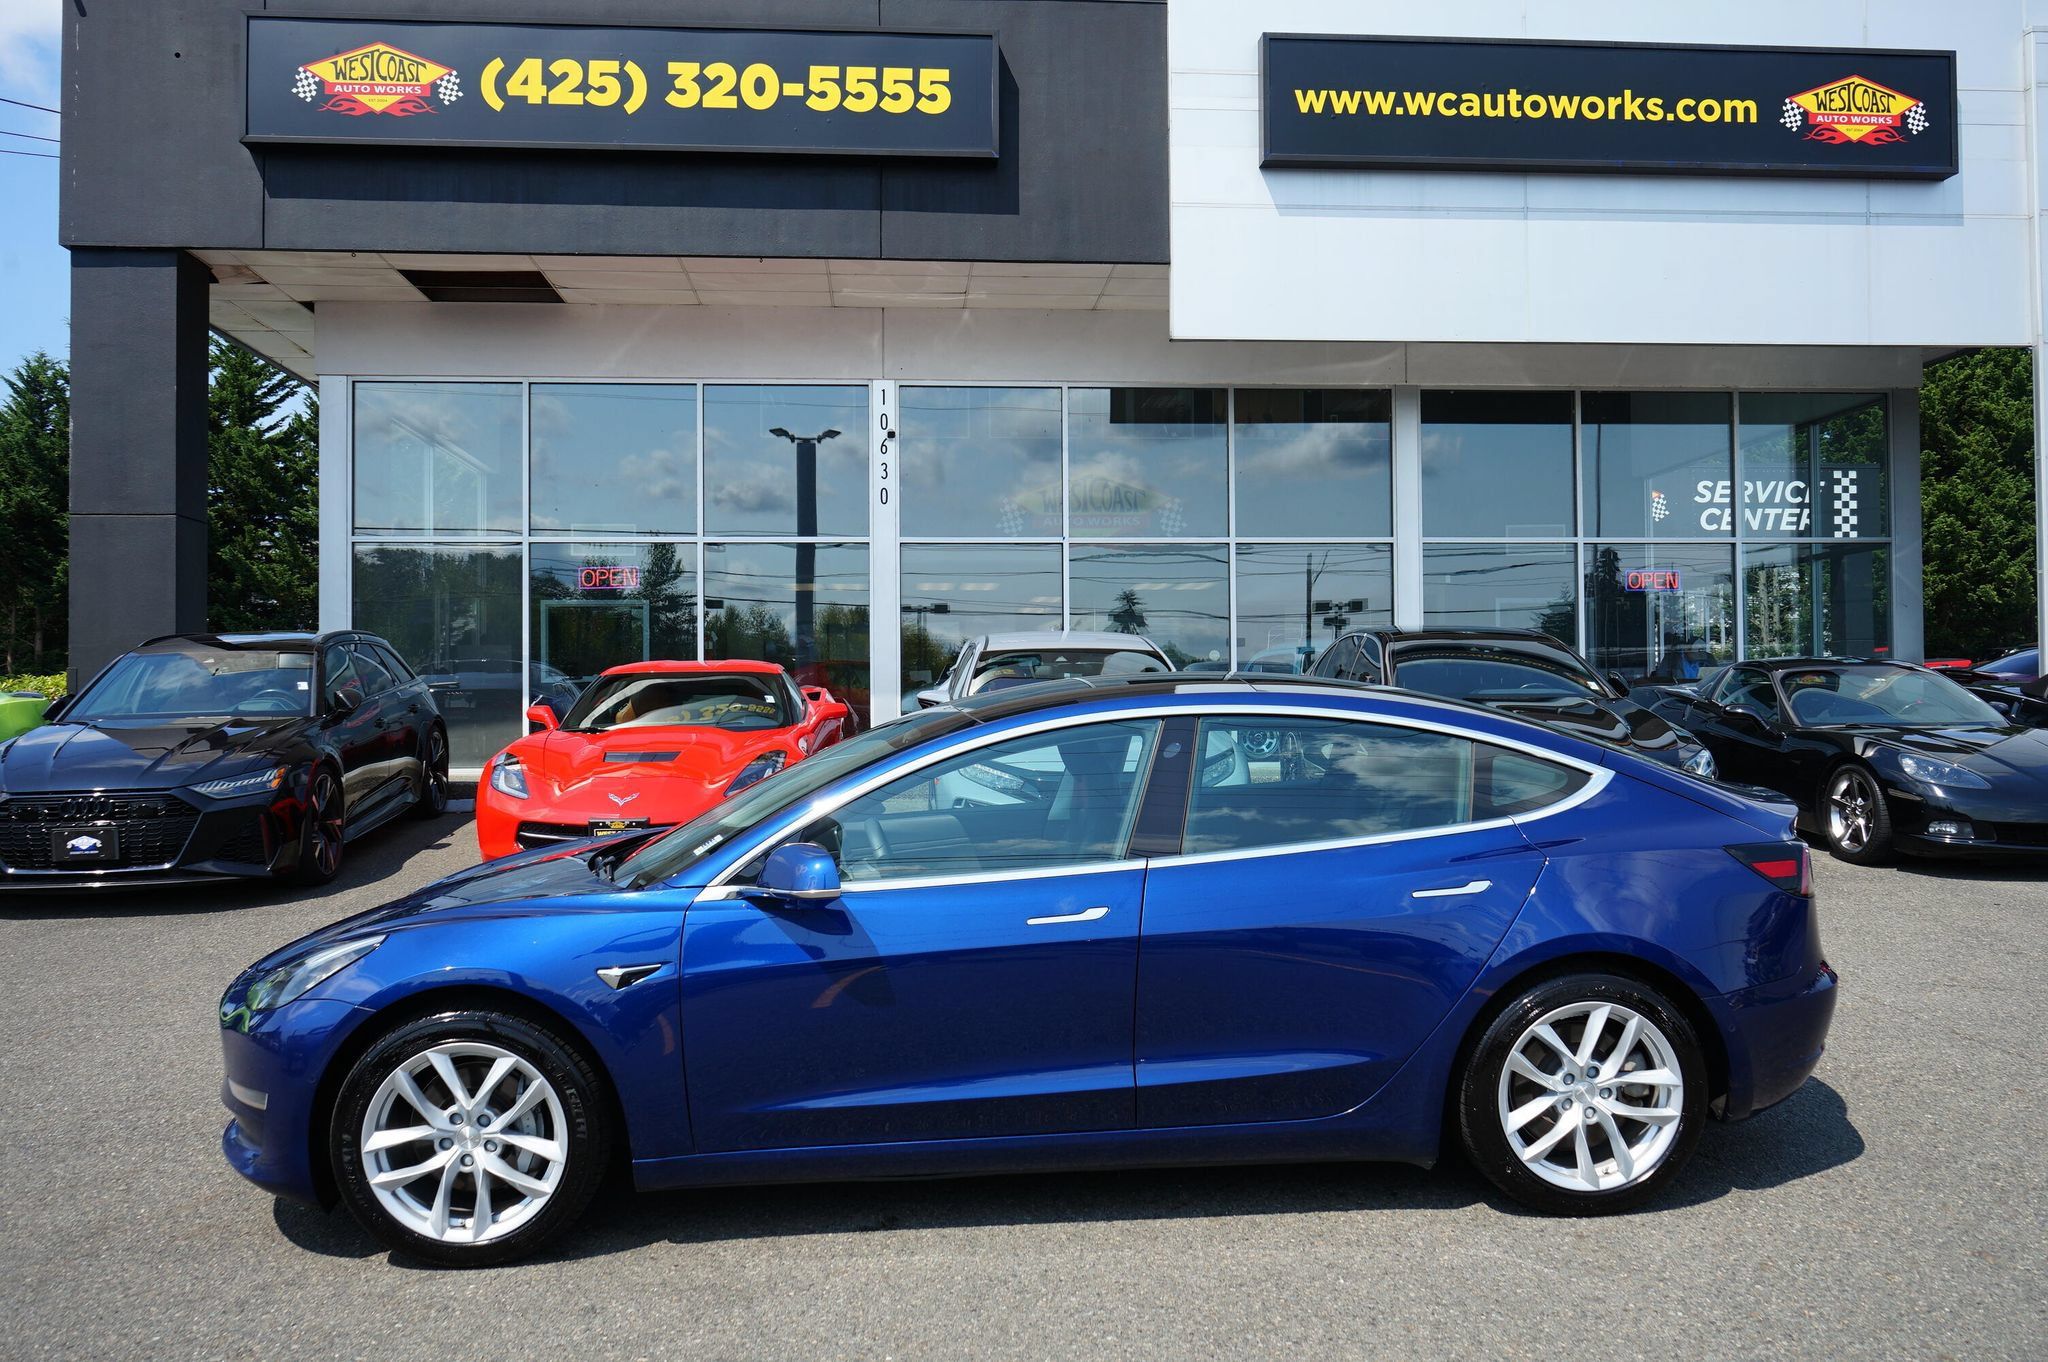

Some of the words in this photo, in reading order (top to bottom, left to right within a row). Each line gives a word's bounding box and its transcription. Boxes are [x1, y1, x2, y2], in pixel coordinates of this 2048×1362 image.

[334, 84, 371, 94] AUTO
[374, 85, 422, 95] WORKS
[480, 56, 648, 115] (425)
[664, 61, 952, 115] 320-5555
[1294, 88, 1758, 124] www.wcautoworks.com
[1816, 115, 1848, 124] AUTO
[1851, 116, 1893, 125] WORKS
[1043, 515, 1083, 527] AUO
[1086, 515, 1142, 527] WORKS
[580, 569, 638, 587] OPEN
[1627, 571, 1679, 589] OPEN
